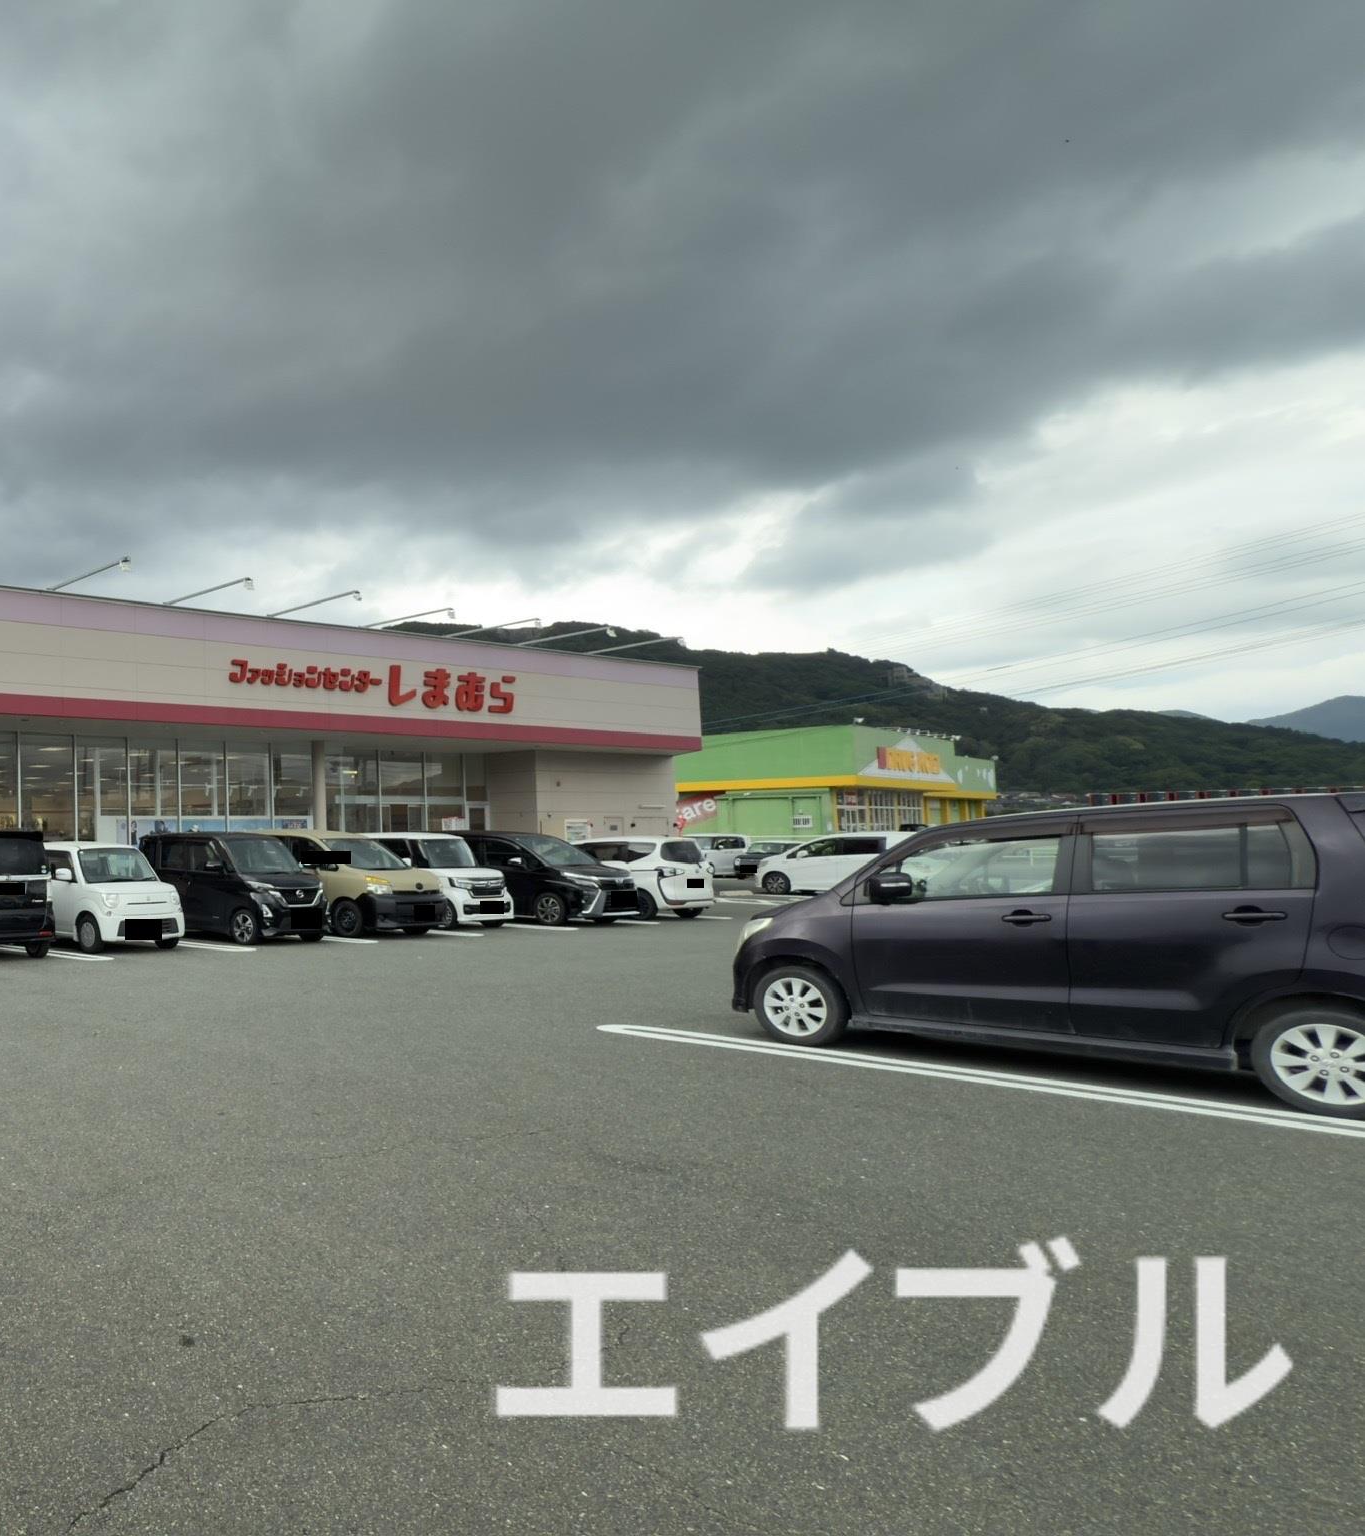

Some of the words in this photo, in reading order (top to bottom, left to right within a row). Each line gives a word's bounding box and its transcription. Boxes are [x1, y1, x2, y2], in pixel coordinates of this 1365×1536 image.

[228, 659, 382, 694] ファッションセンター
[388, 665, 516, 714] しまむら
[676, 799, 716, 820] are
